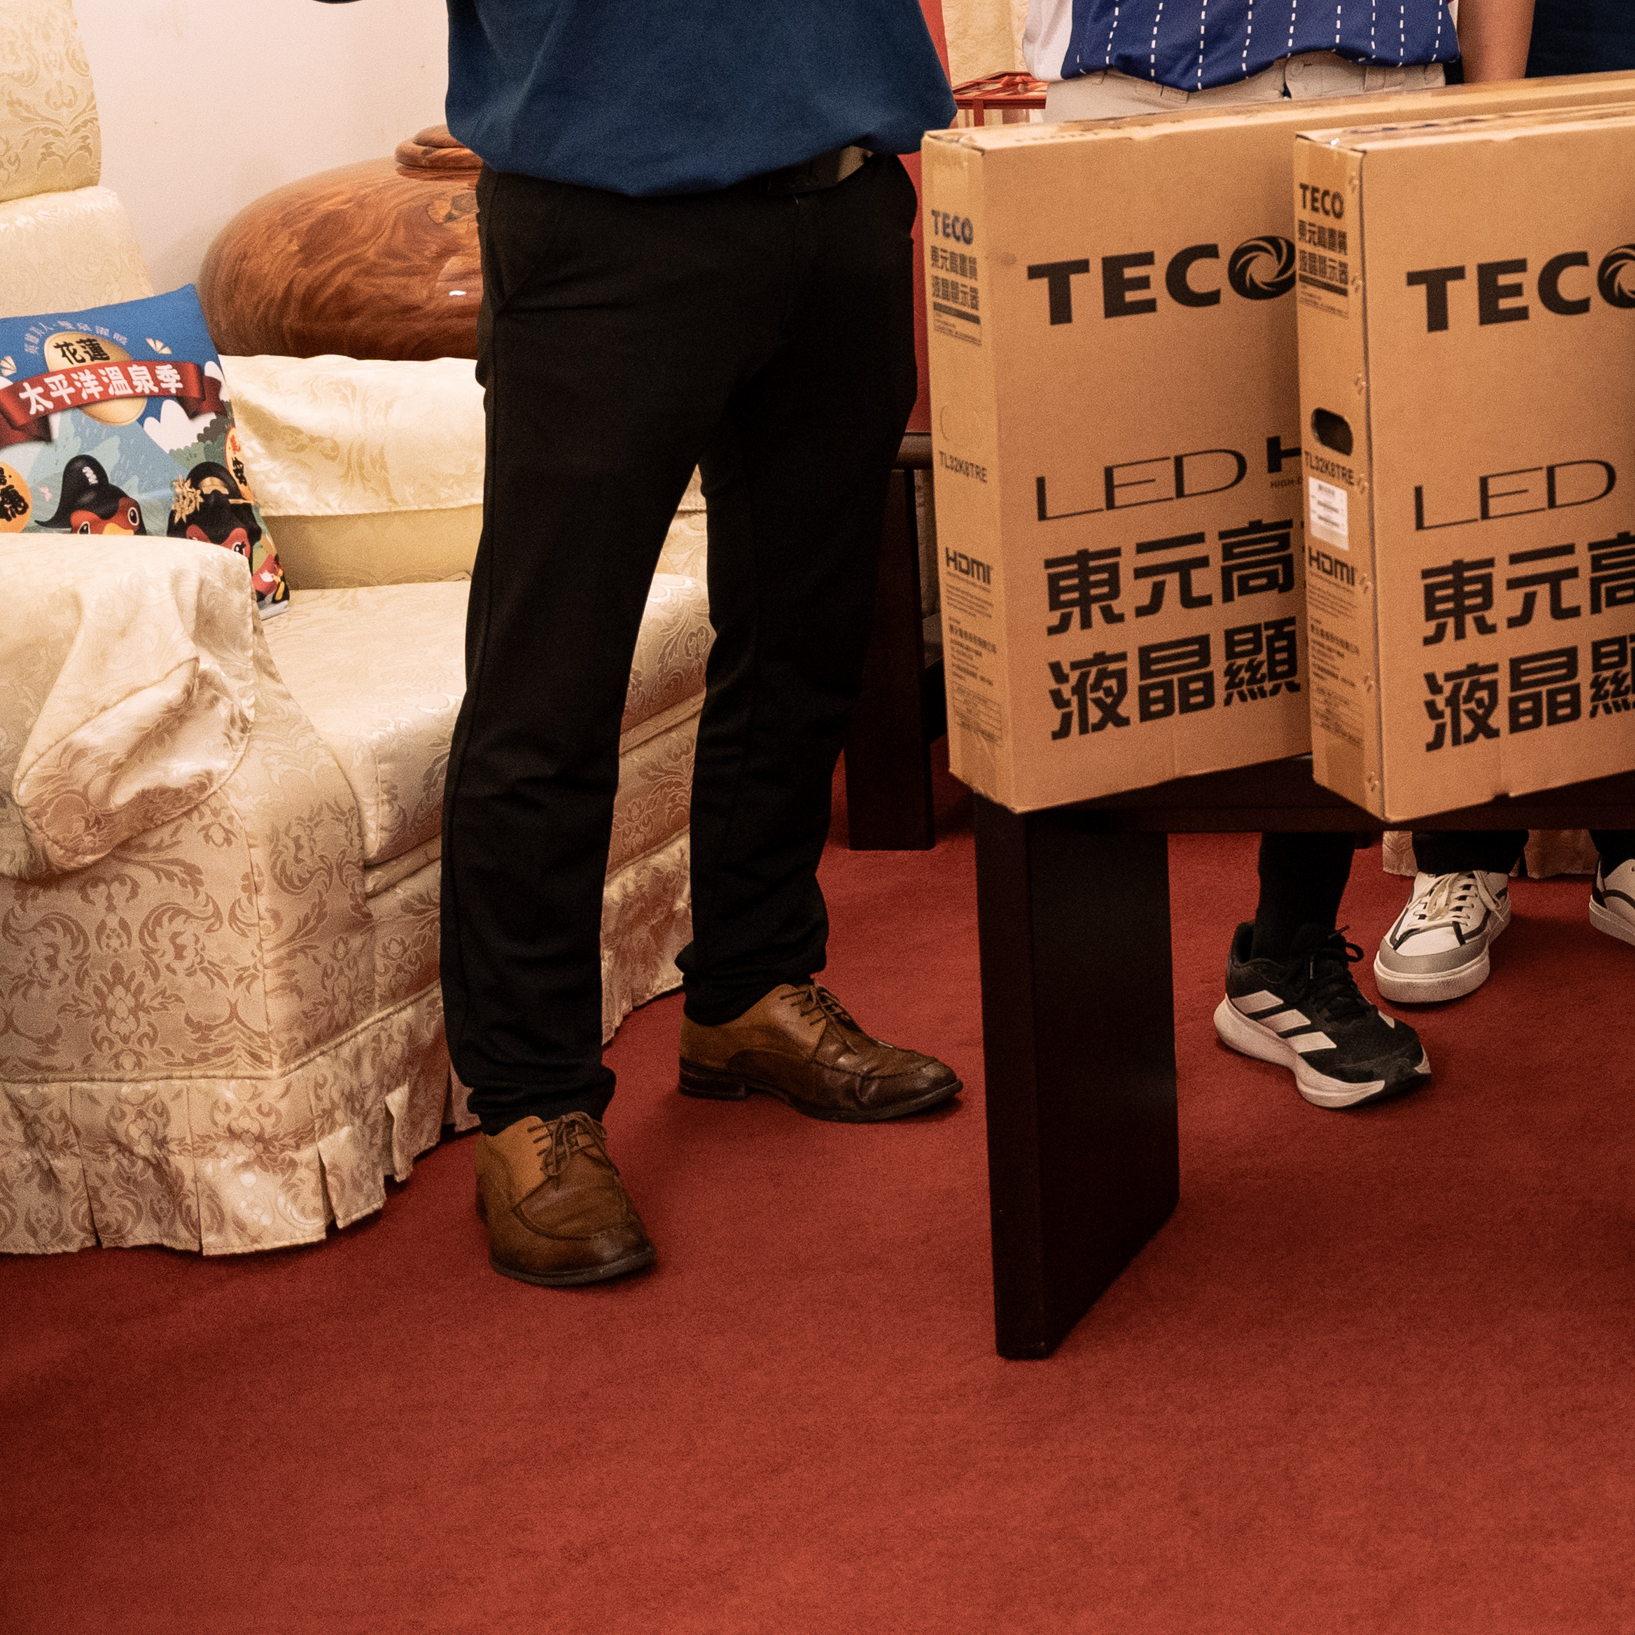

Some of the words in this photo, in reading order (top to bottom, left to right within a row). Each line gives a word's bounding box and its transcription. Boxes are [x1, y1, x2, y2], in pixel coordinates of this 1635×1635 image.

[931, 209, 974, 245] TECO
[1299, 182, 1345, 220] TECO
[1027, 235, 1295, 325] TECO
[54, 337, 110, 365] 花蓮
[1036, 449, 1248, 522] LED
[1413, 458, 1617, 532] LED
